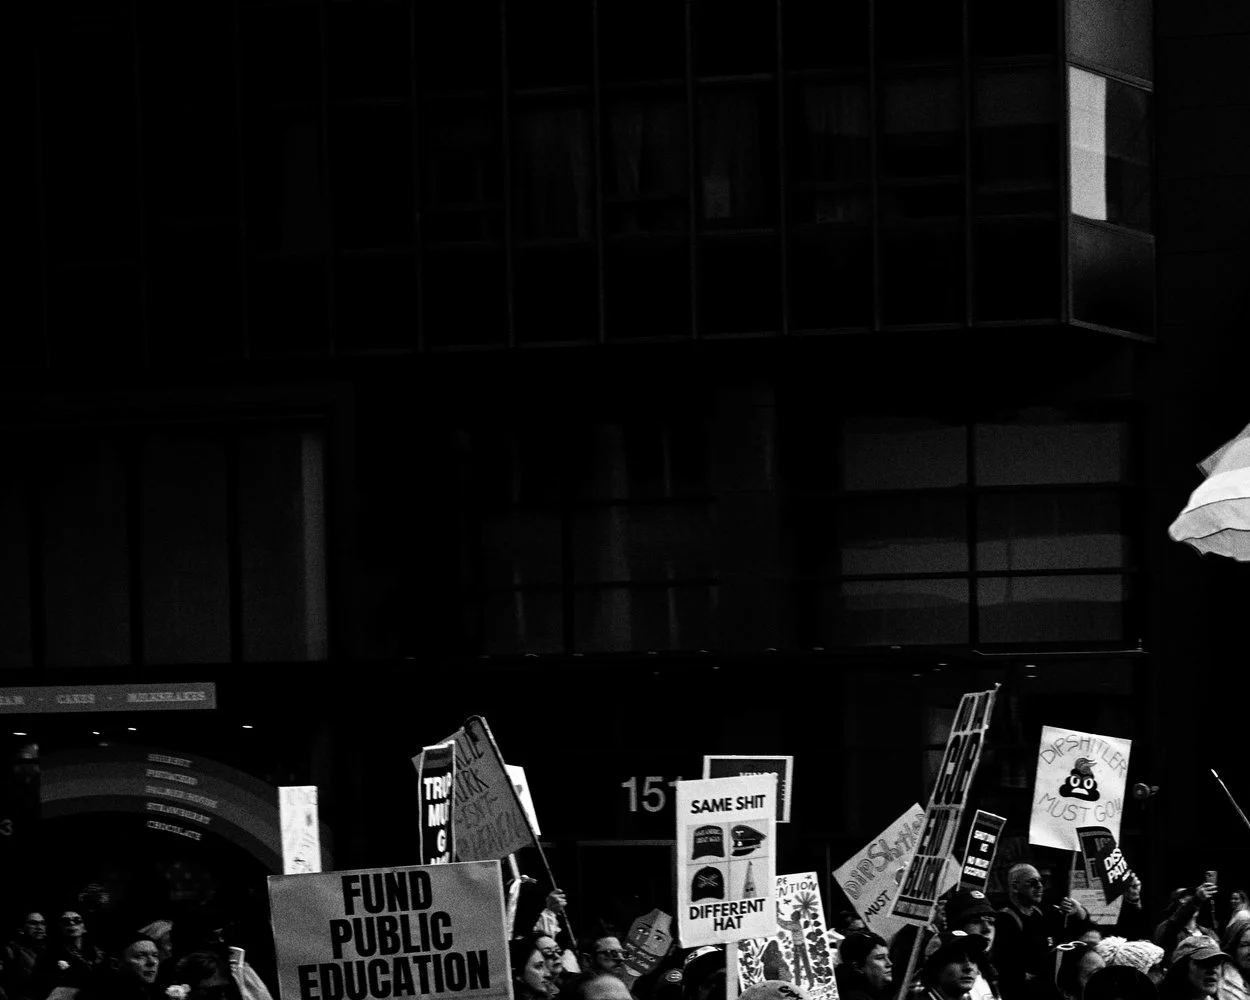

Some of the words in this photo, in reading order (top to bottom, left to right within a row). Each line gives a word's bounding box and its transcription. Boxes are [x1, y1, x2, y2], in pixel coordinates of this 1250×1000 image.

[620, 775, 683, 813] 15
[690, 796, 733, 814] SAME
[735, 794, 766, 812] SHIT
[1037, 792, 1092, 823] MUST
[341, 870, 433, 916] FUND
[689, 898, 766, 920] DIFFERENT
[863, 889, 892, 923] MUST
[329, 911, 453, 959] PUBLIC
[713, 916, 744, 932] HAT
